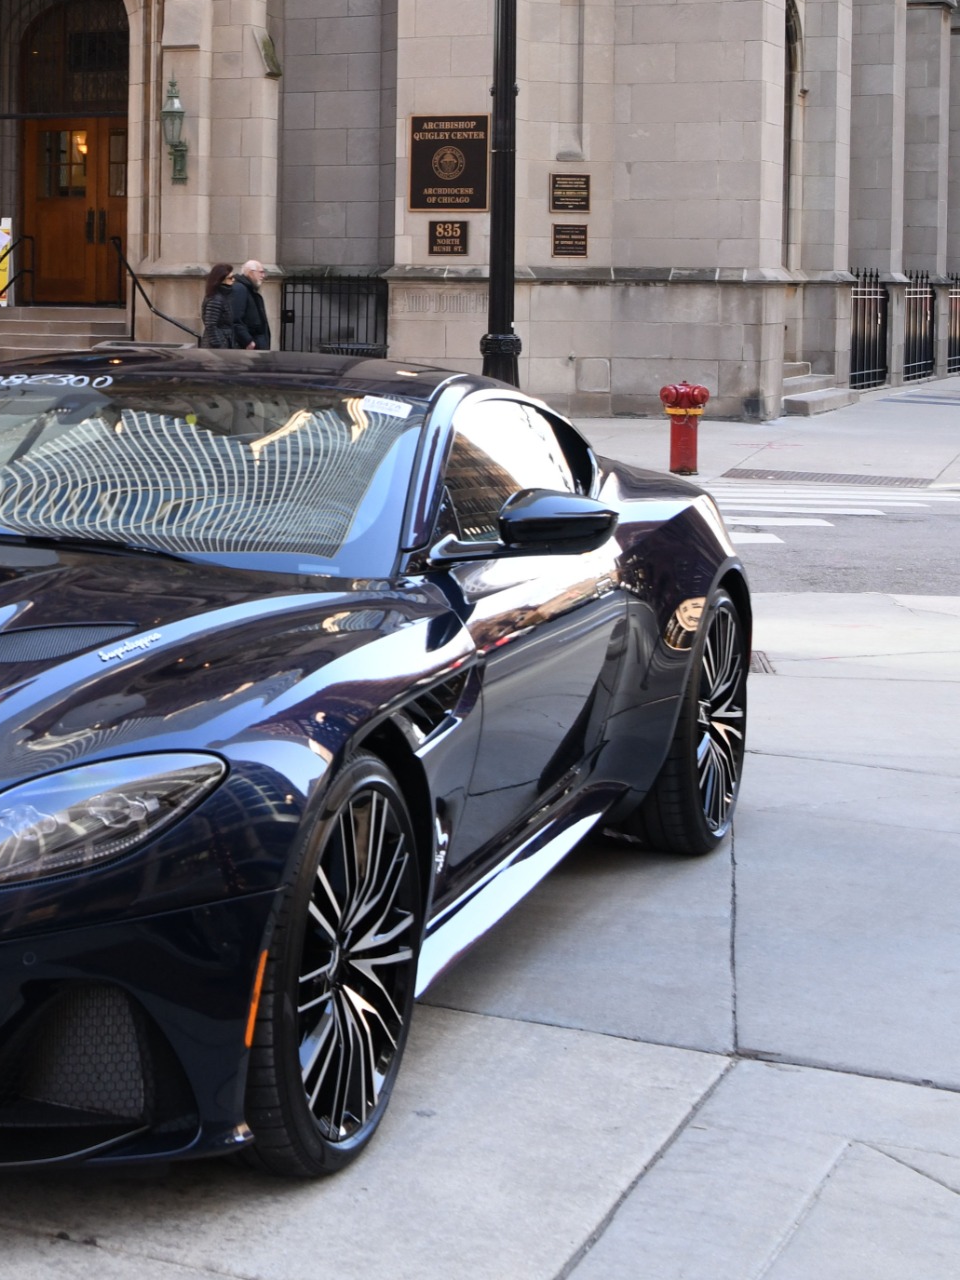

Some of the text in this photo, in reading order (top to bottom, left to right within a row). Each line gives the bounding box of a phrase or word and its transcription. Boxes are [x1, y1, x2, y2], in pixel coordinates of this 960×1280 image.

[422, 121, 476, 130] ARCHBISHOP
[413, 131, 485, 140] QUIGLEY CENTER
[423, 187, 474, 195] ARCHDIOCESE
[426, 196, 470, 204] OF CHICAGO
[436, 223, 461, 237] 835
